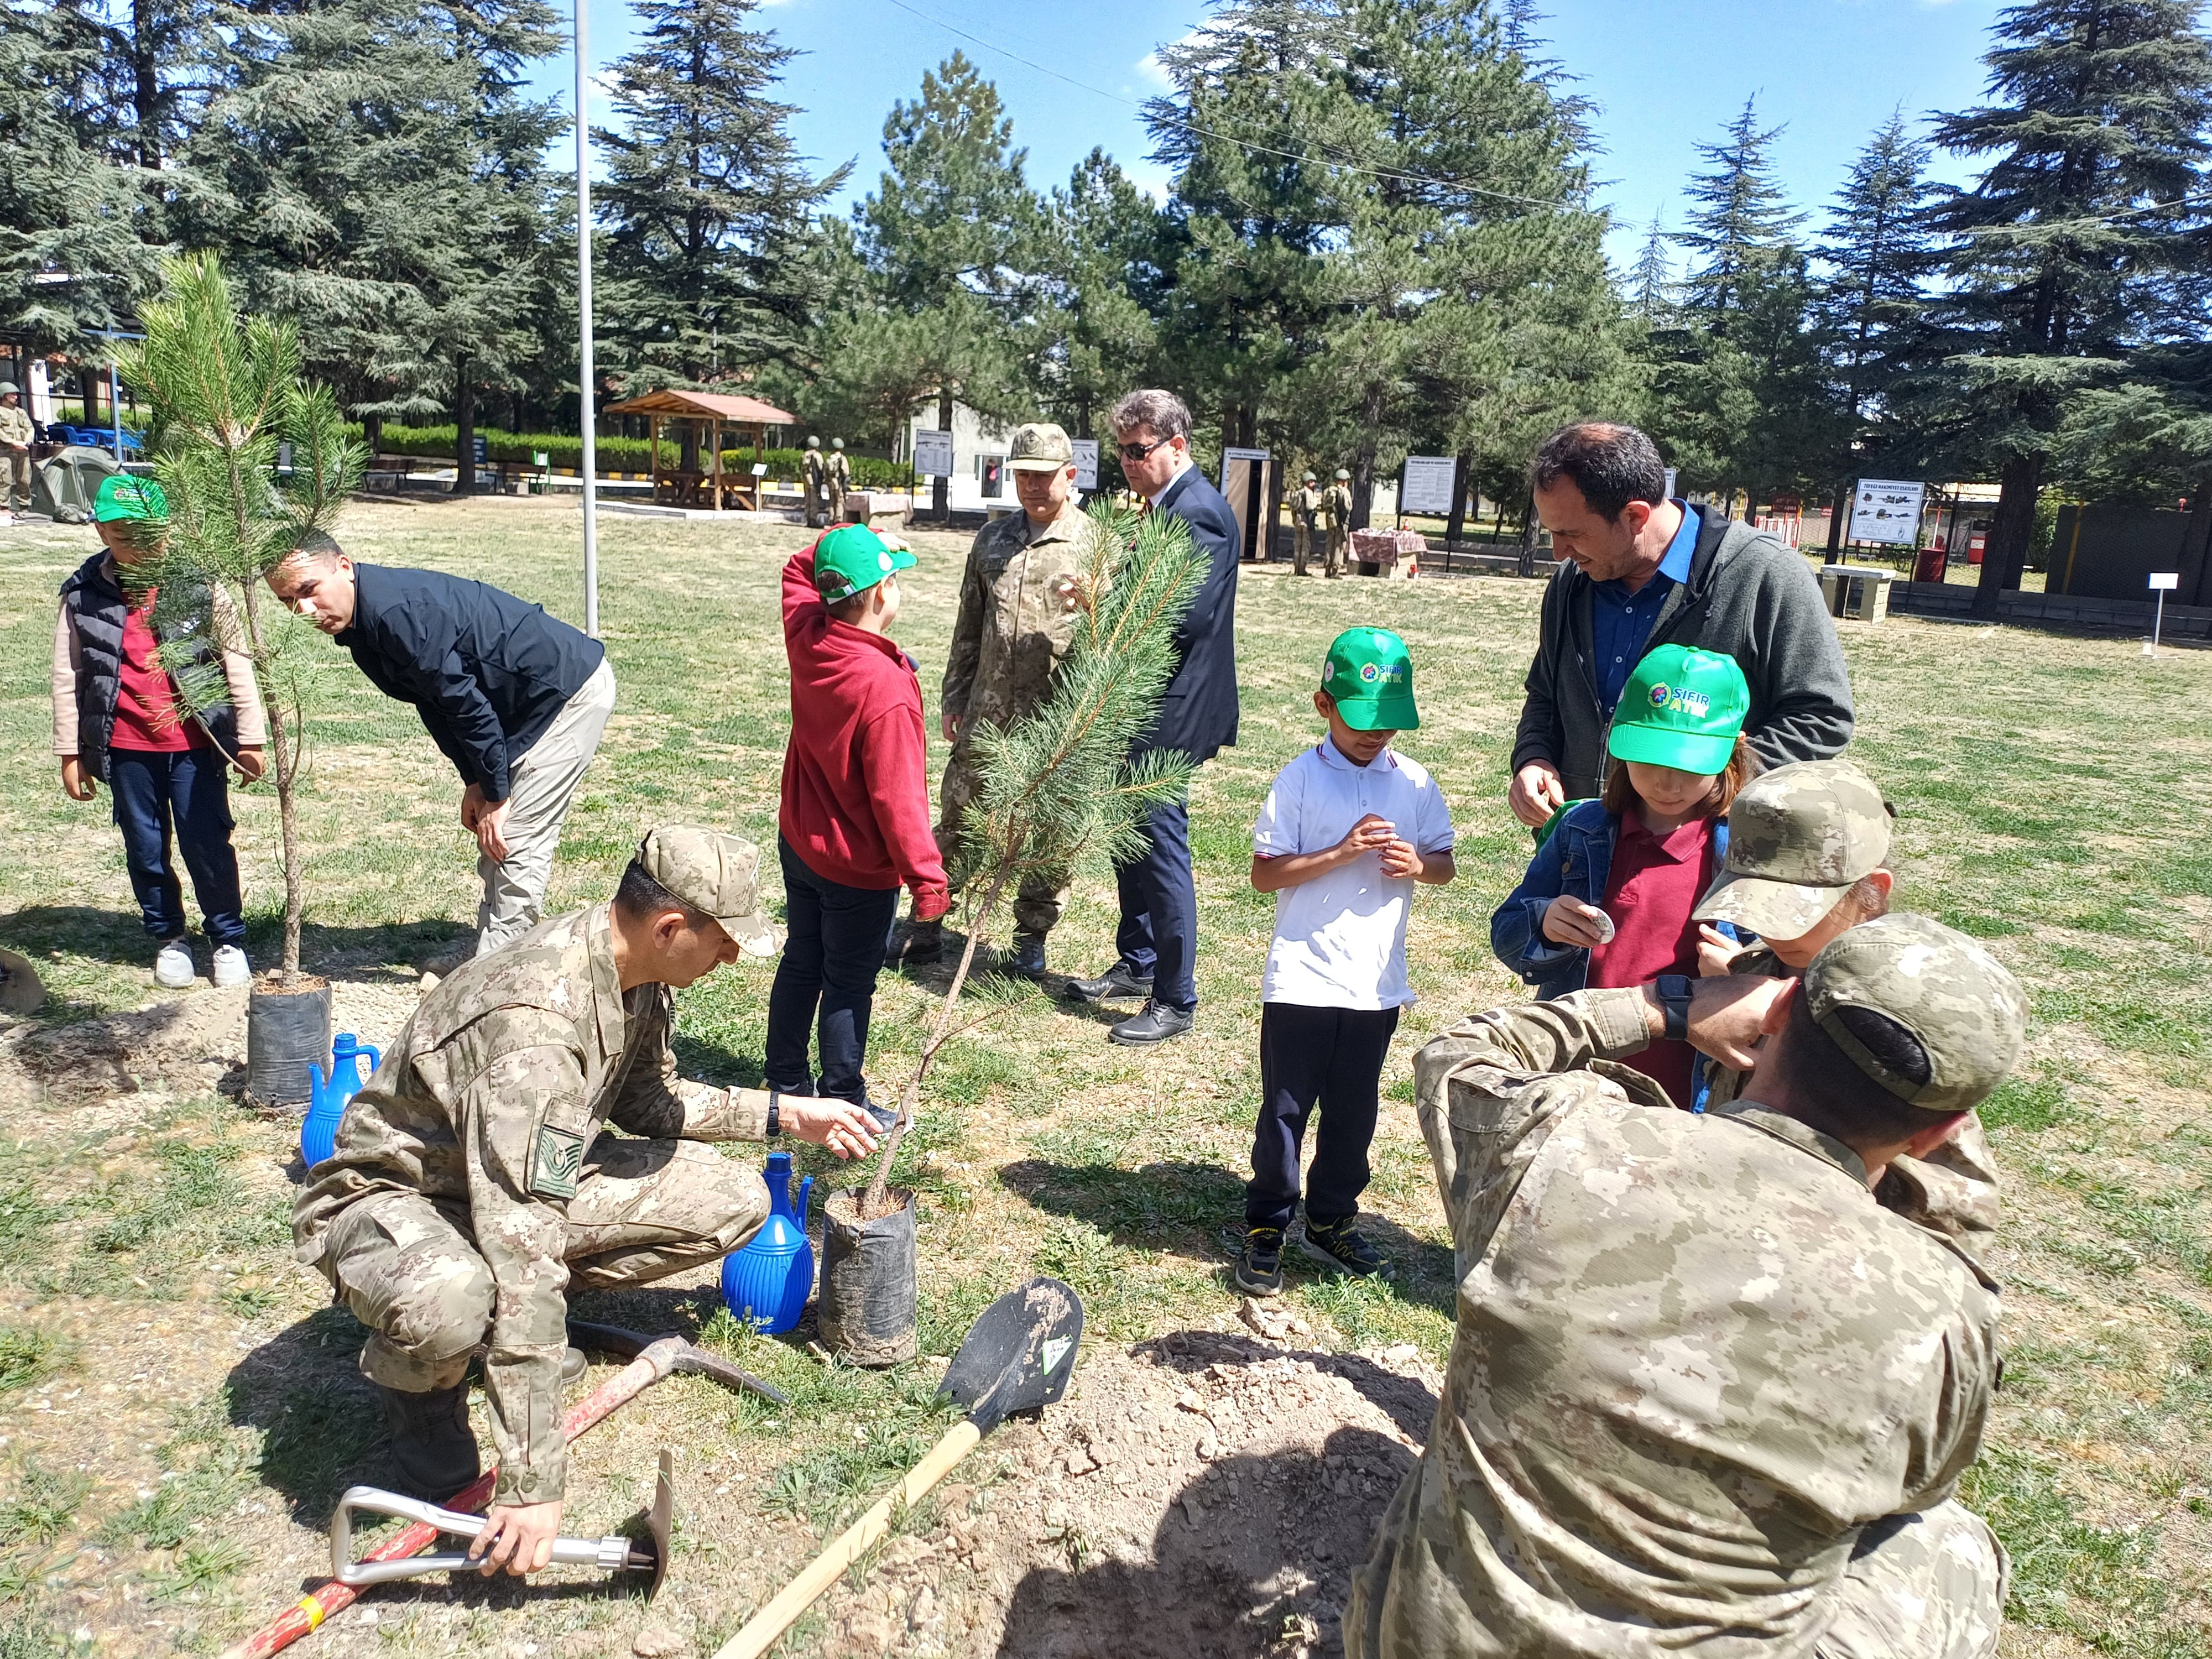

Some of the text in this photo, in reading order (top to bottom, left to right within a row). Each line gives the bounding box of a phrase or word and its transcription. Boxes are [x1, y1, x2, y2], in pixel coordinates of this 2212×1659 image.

[1380, 665, 1401, 674] SIFIR
[1379, 674, 1402, 684] ATIK
[1673, 688, 1709, 706] SIFIR
